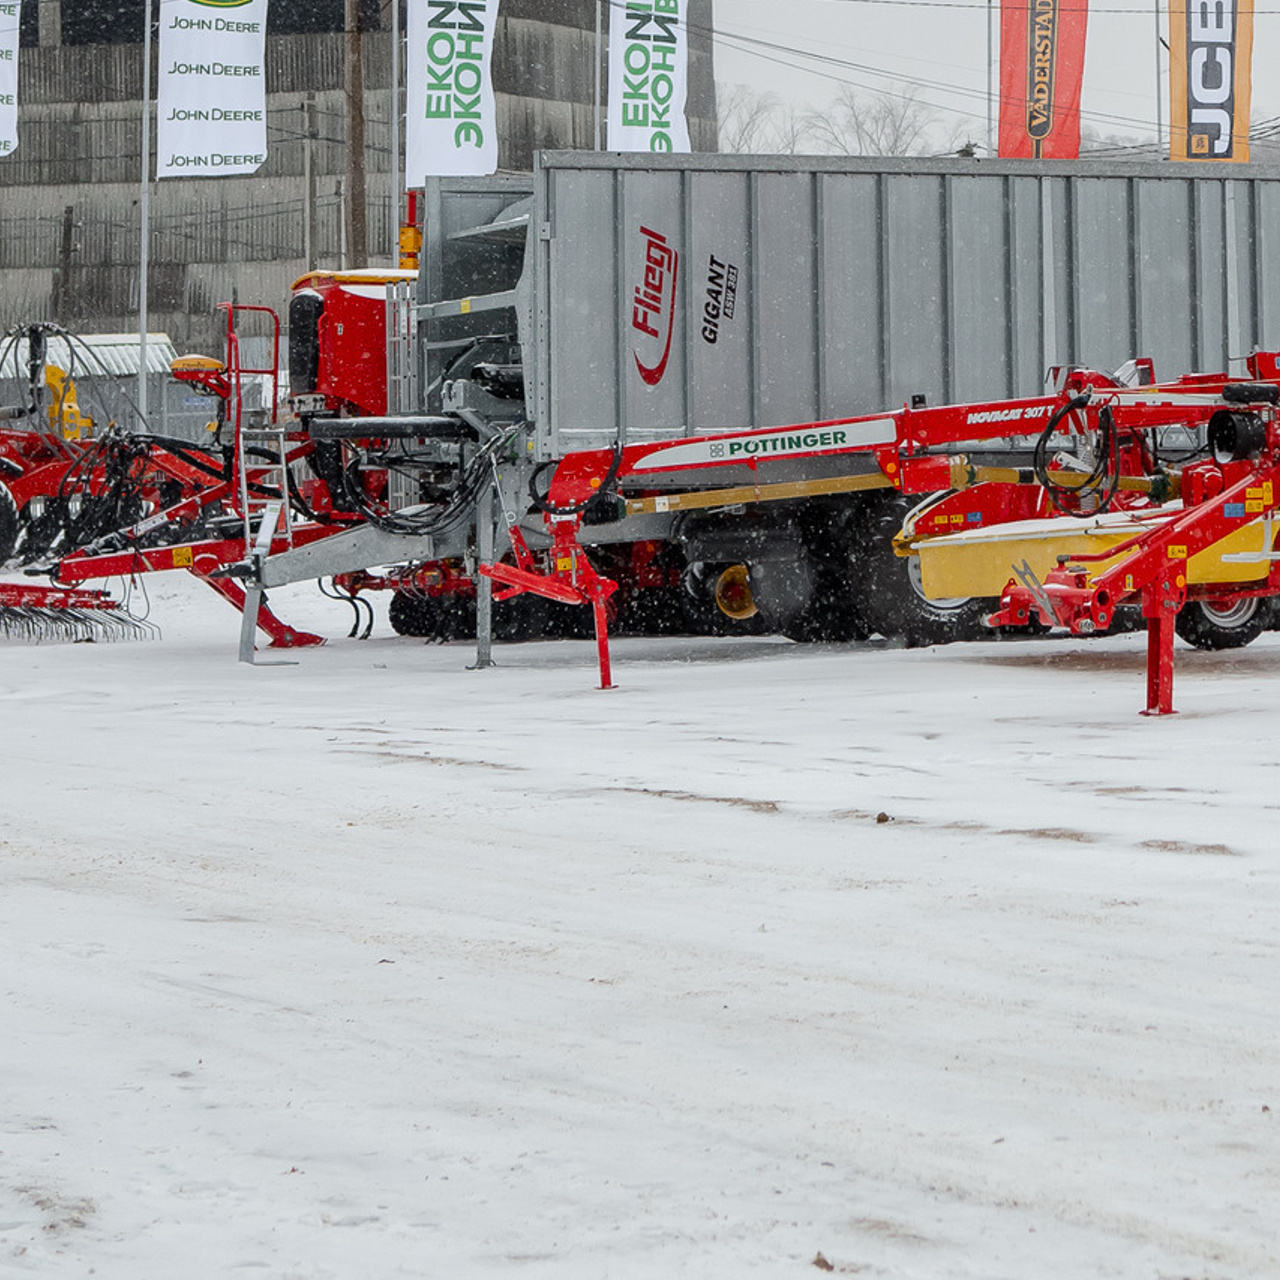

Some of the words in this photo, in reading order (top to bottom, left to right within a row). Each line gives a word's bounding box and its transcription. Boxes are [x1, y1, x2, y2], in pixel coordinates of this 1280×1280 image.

[168, 16, 211, 30] JOHN
[215, 18, 260, 33] DEERE
[168, 61, 210, 75] JOHN
[212, 62, 260, 77] DEERE
[167, 108, 209, 121] JOHN
[211, 108, 263, 121] DEERE
[166, 154, 208, 167] JOHN
[210, 153, 264, 166] DEERE
[632, 225, 673, 339] Fliegl
[701, 254, 725, 345] GIGANT
[724, 289, 735, 318] ASW
[1023, 406, 1045, 419] 307
[1046, 405, 1055, 417] T
